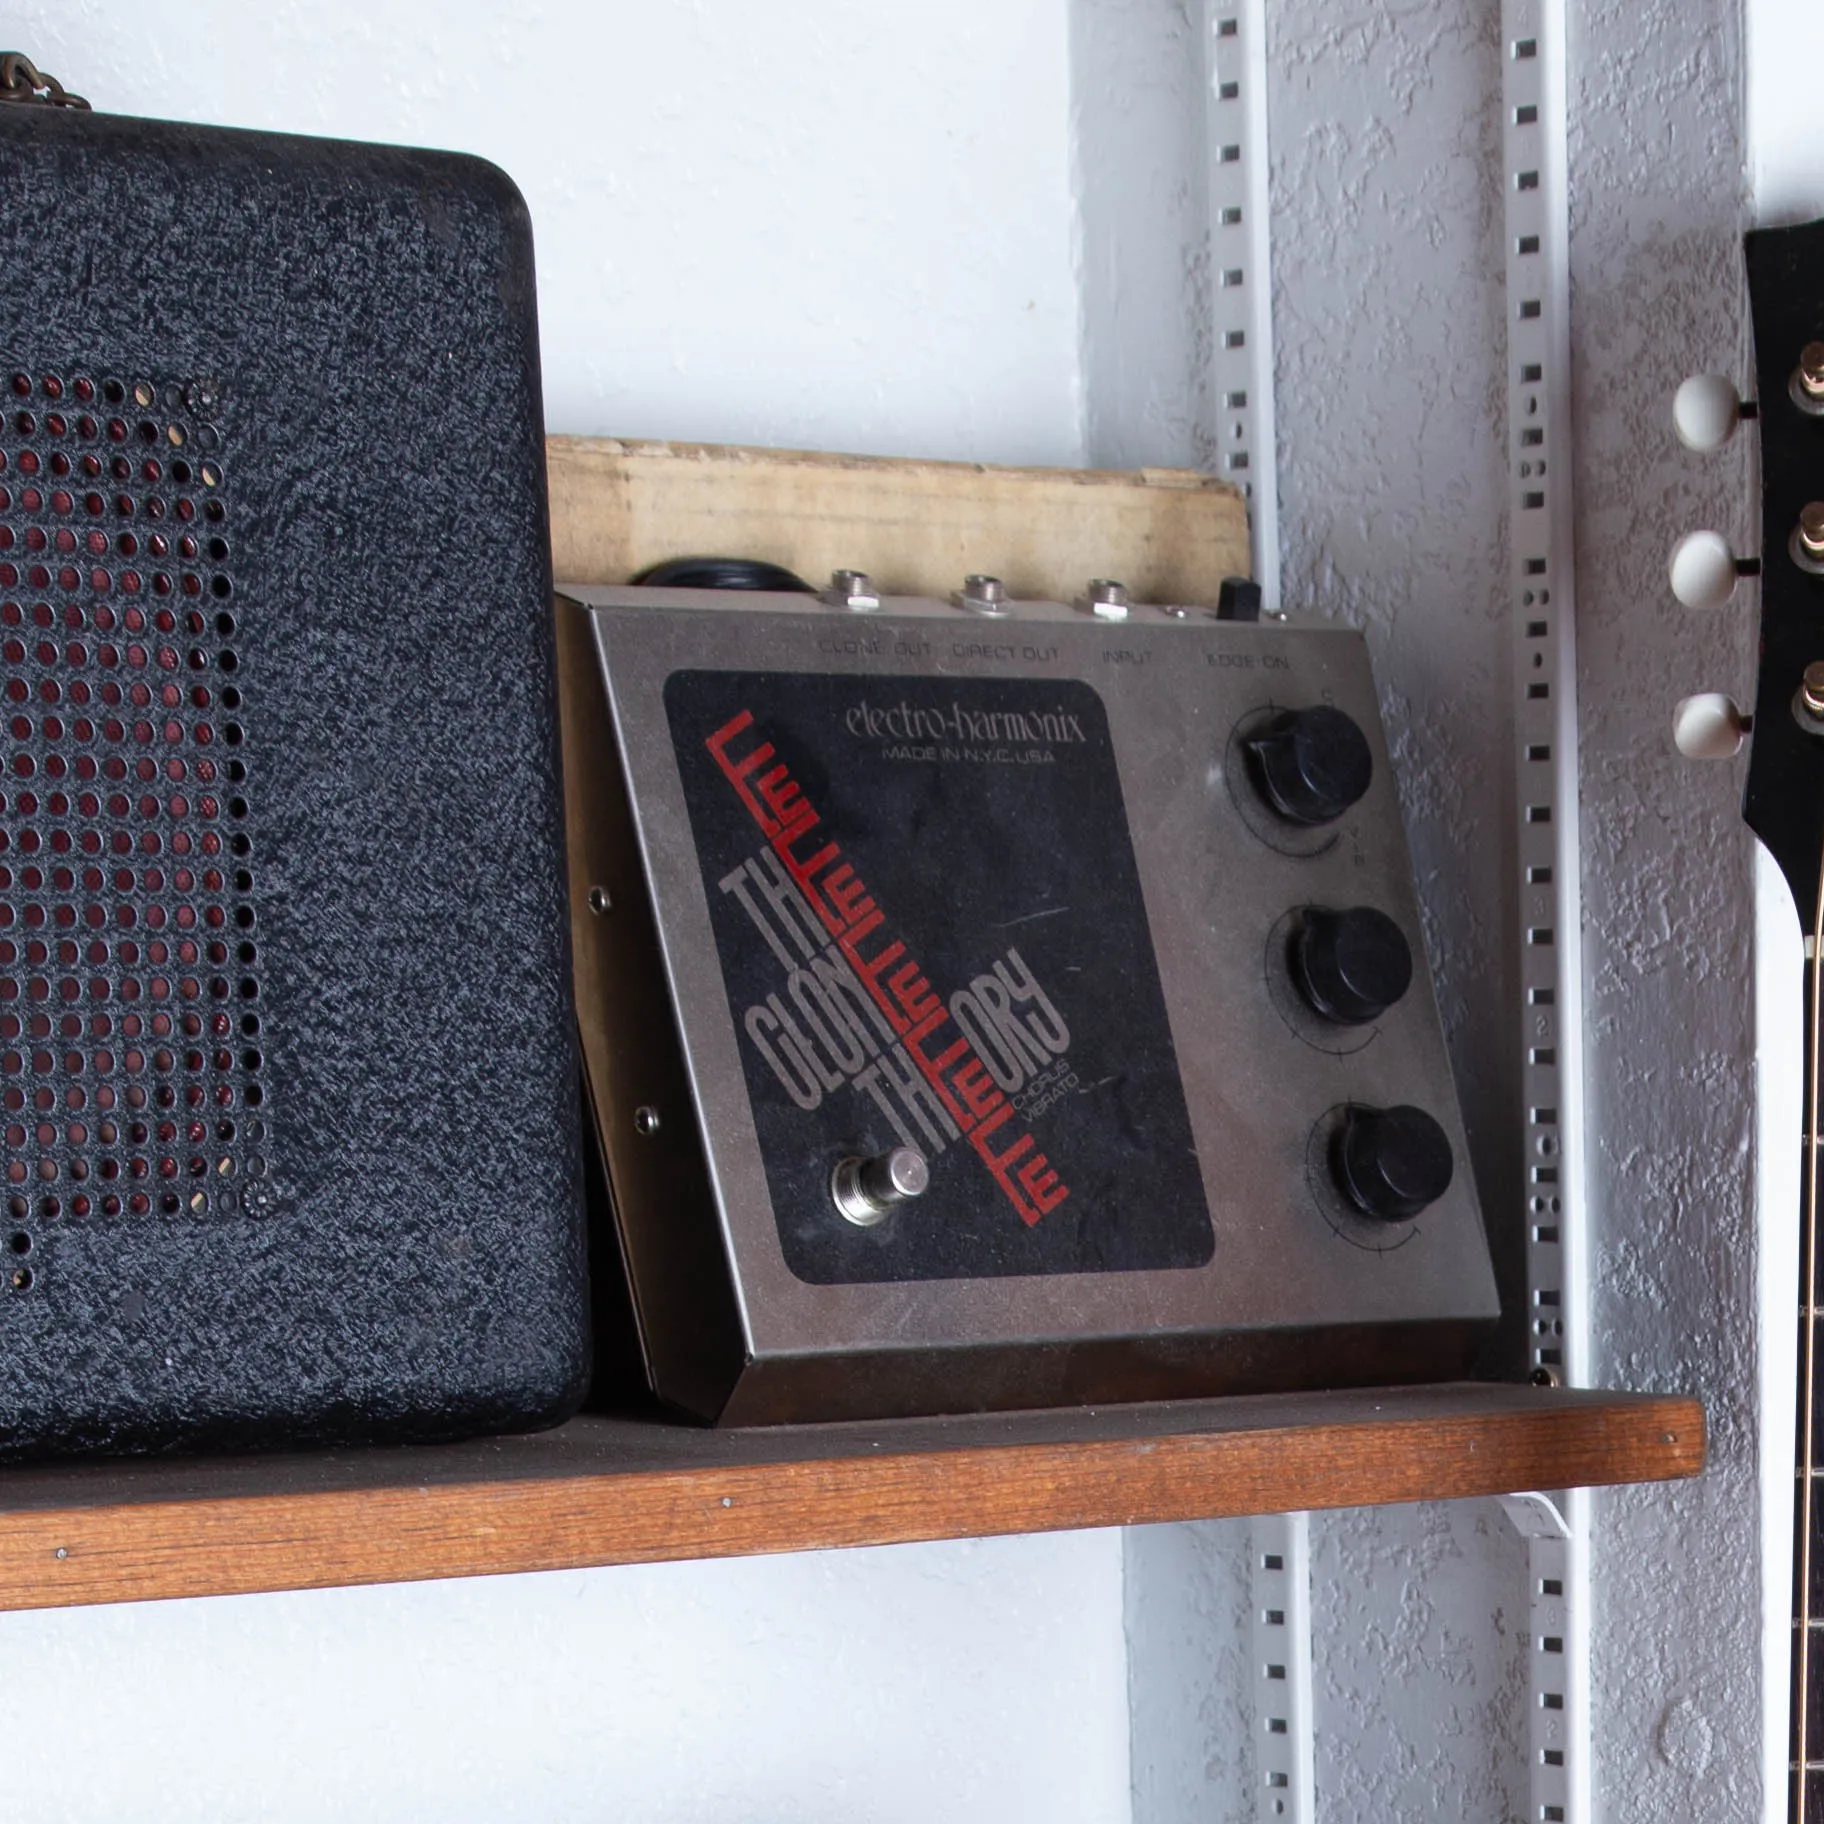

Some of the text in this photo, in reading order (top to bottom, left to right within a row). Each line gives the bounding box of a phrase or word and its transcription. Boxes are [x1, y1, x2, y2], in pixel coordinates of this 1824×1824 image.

[818, 640, 932, 658] CLONE OUT
[951, 643, 1061, 663] DIRECT OUT
[1101, 648, 1153, 665] INPUT
[845, 698, 1088, 744] electro-harmonix
[881, 746, 938, 763] MADE
[941, 748, 962, 763] IN
[1010, 1058, 1071, 1112] CHORUS
[1022, 1074, 1081, 1125] VIBRATO
